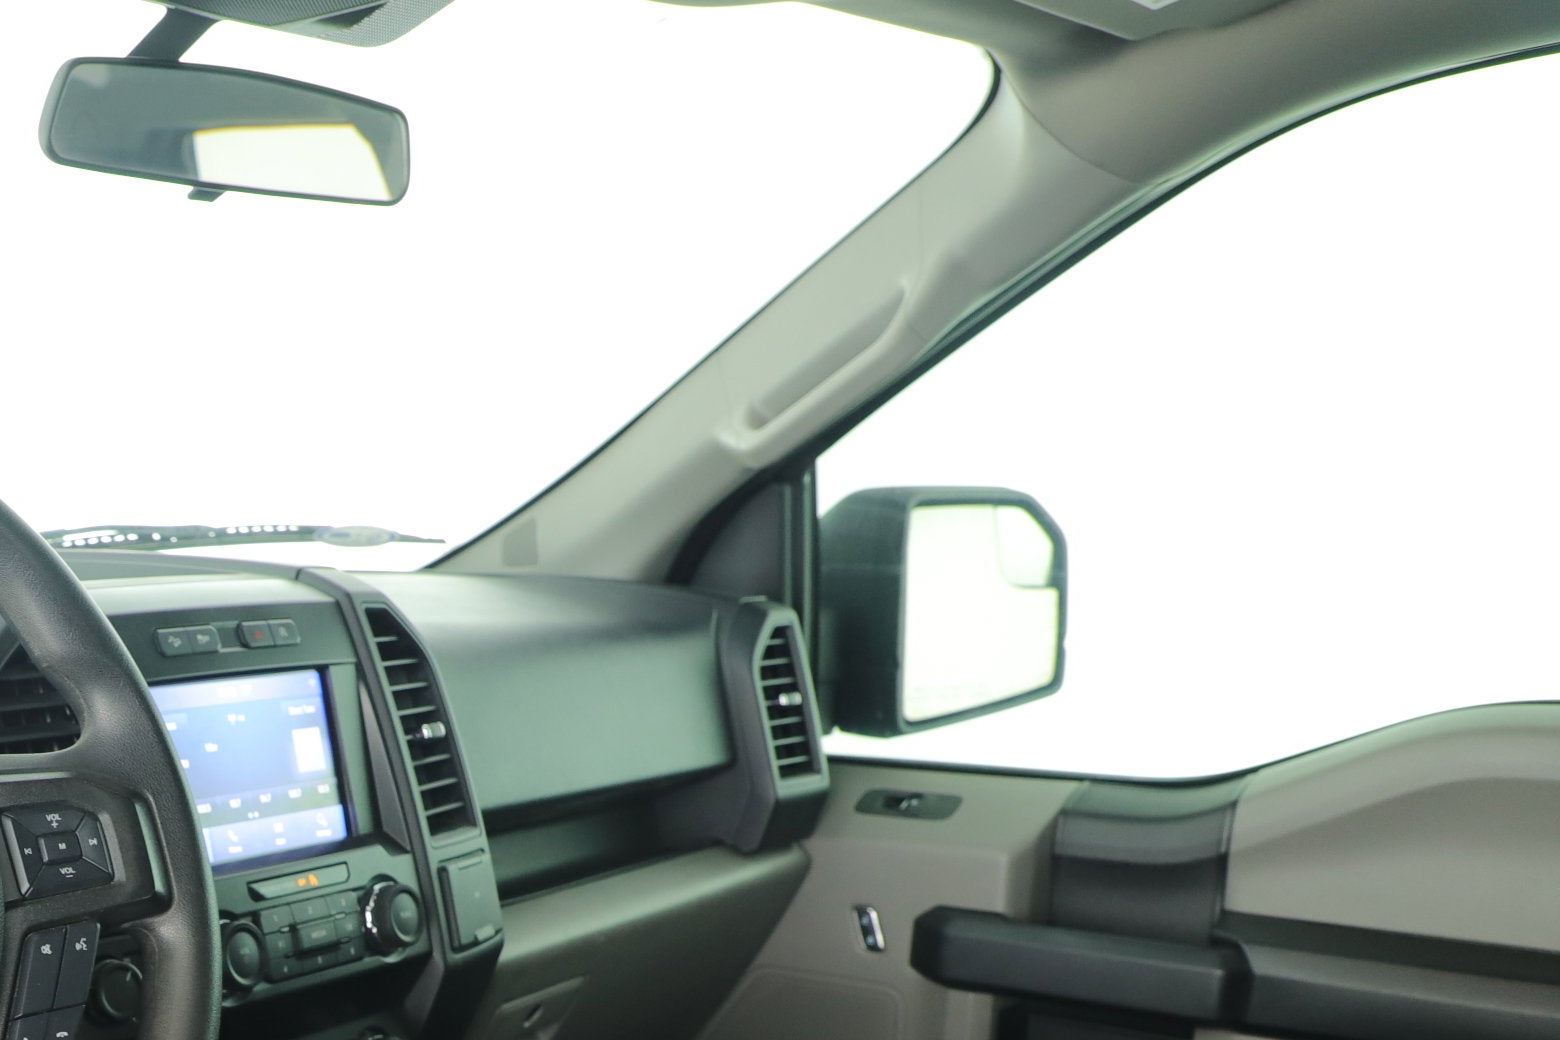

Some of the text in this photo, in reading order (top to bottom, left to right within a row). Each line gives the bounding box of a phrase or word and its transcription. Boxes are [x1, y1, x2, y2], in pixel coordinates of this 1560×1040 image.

[45, 813, 63, 822] VOL
[58, 842, 68, 850] M
[59, 866, 77, 875] VOL
